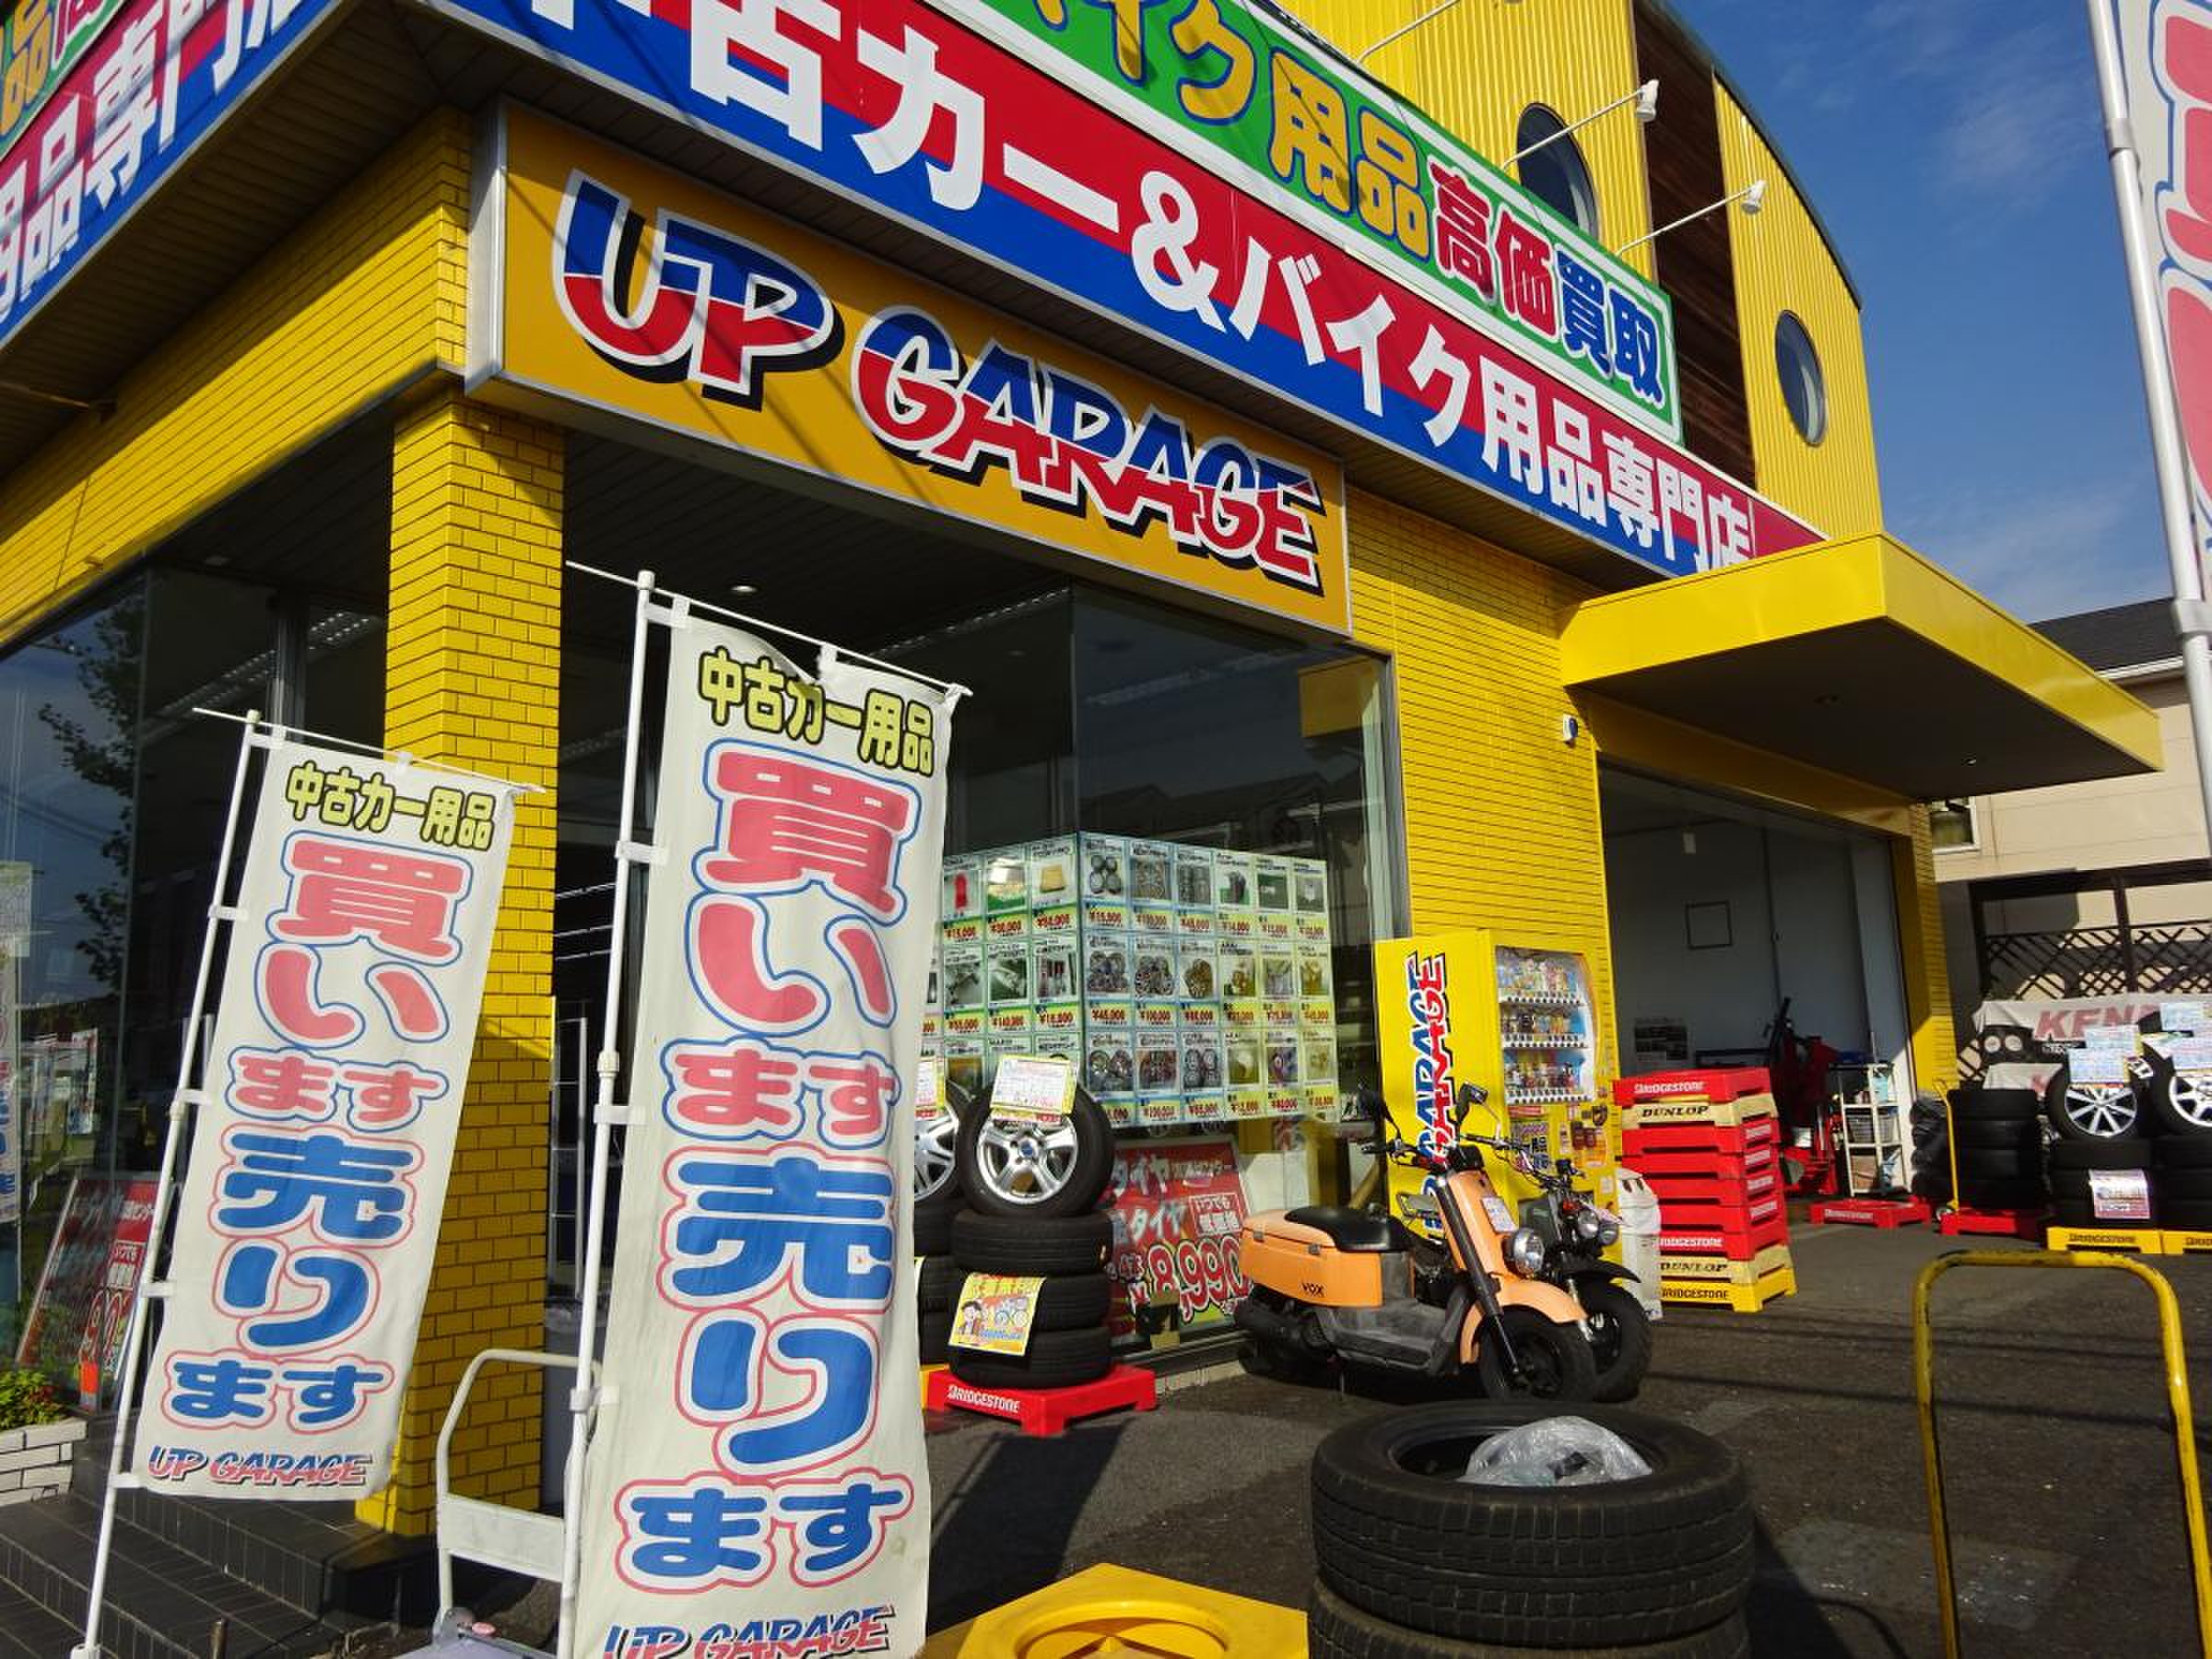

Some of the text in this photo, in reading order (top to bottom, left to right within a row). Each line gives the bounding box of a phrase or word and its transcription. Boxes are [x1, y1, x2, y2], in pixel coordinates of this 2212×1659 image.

[553, 169, 1324, 597] UP GARAGE
[698, 646, 935, 776] 中古カー用品
[284, 760, 497, 851] 中古カー用品
[1405, 950, 1454, 1163] GARAGE
[1641, 1106, 1710, 1118] DUNLOP
[1660, 1262, 1728, 1272] DUNLOP
[947, 1383, 1021, 1414] BRIDGESTONE
[147, 1444, 373, 1487] UP GARAGE
[603, 1604, 897, 1659] UP GARAGE
